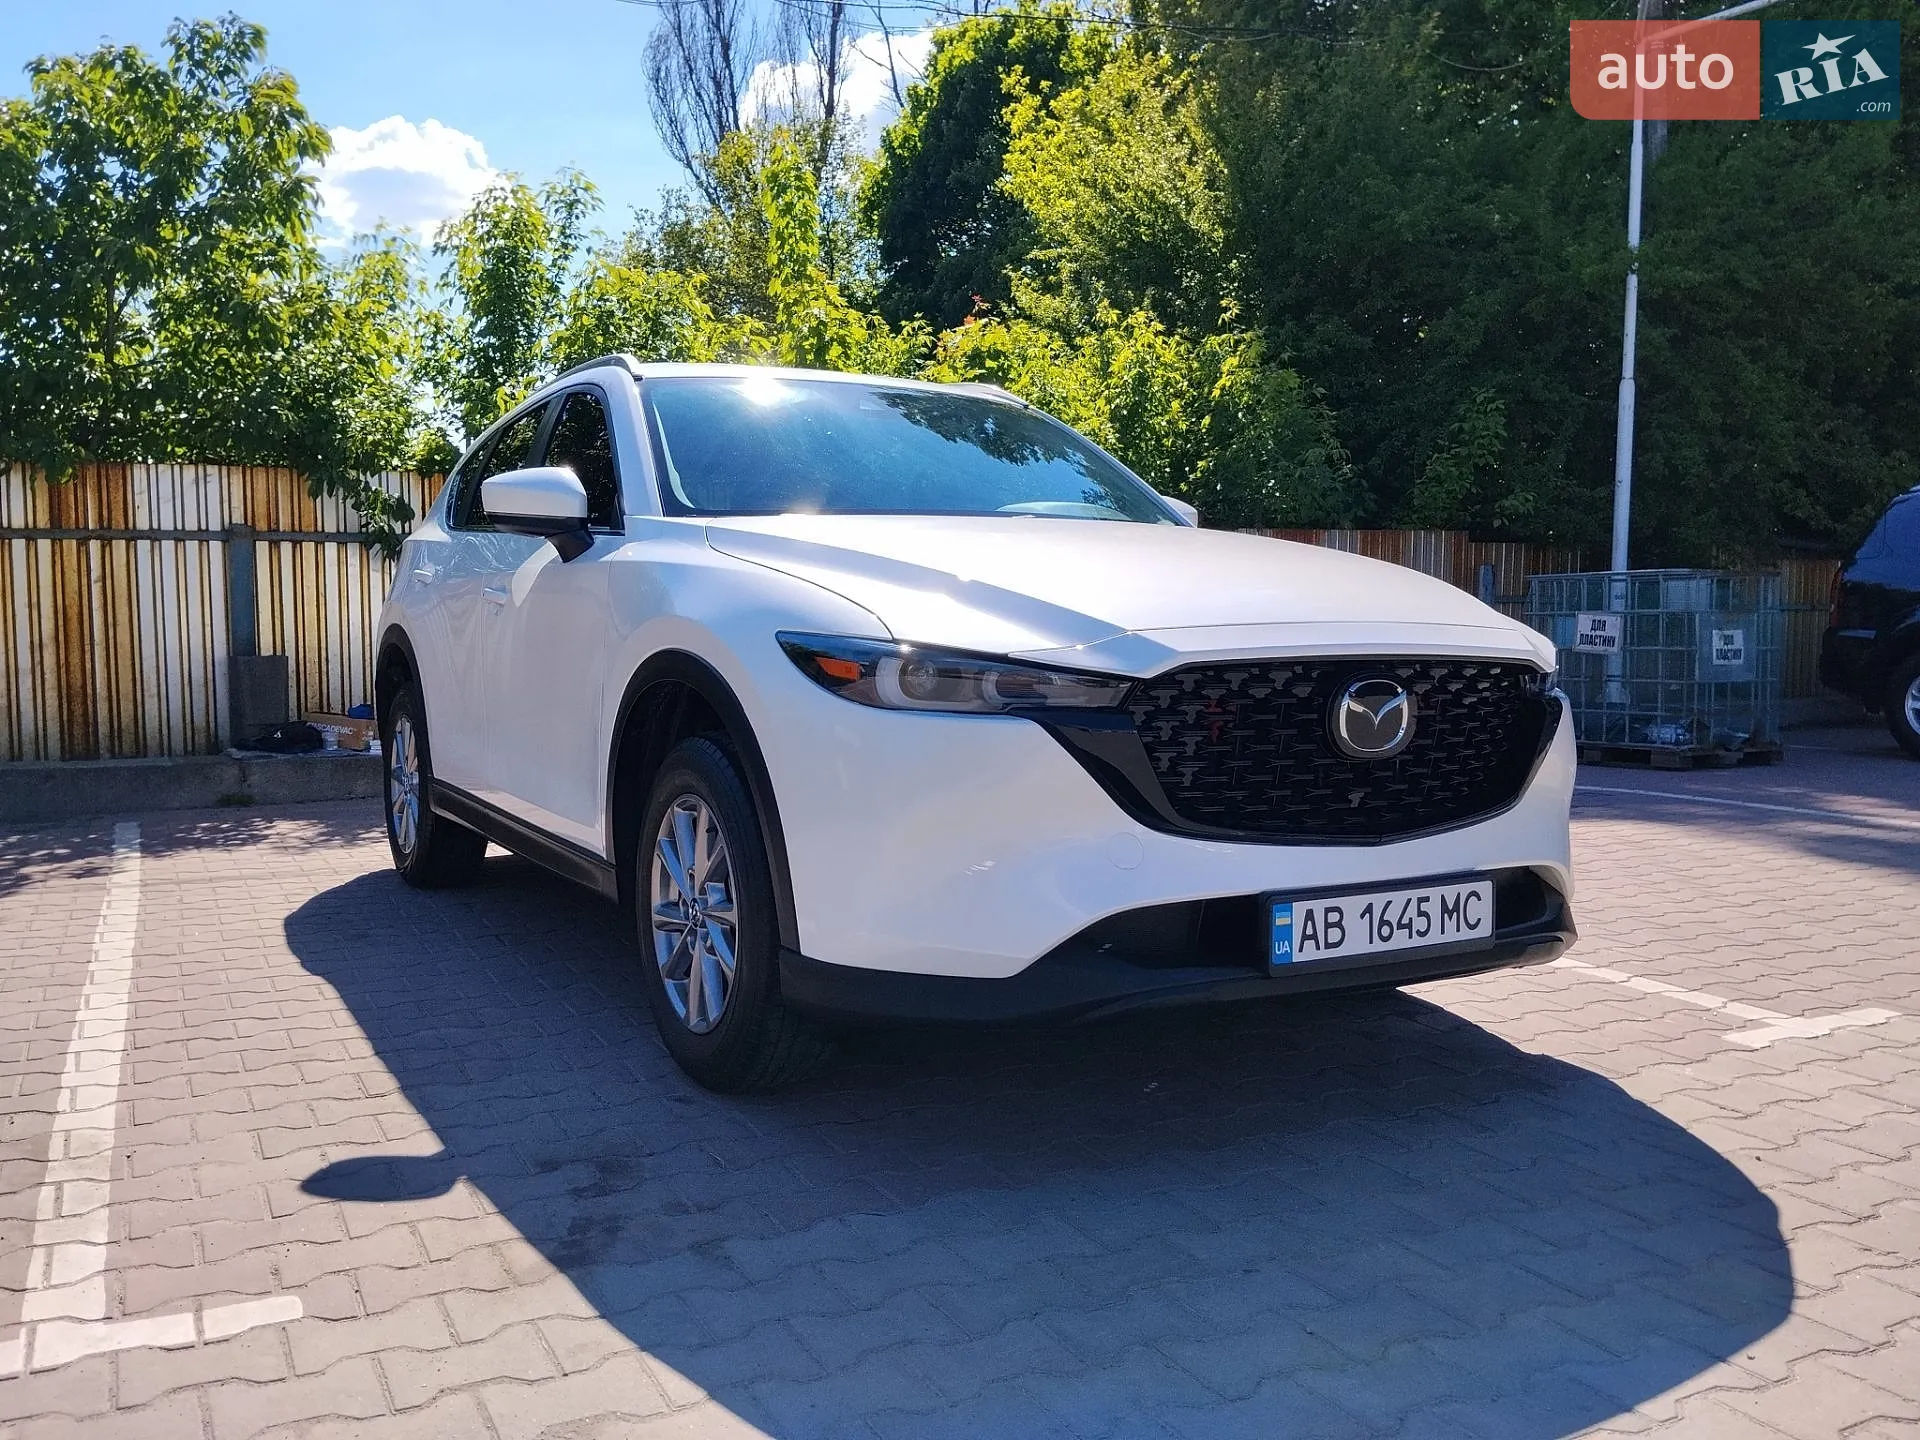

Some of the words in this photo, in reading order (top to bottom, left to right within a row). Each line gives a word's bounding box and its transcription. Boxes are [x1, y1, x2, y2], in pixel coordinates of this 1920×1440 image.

[1590, 618, 1607, 632] ДЛЯ
[1298, 905, 1346, 953] AB
[1359, 895, 1432, 945] 1645
[1440, 889, 1482, 935] MC
[1275, 940, 1290, 954] UA
